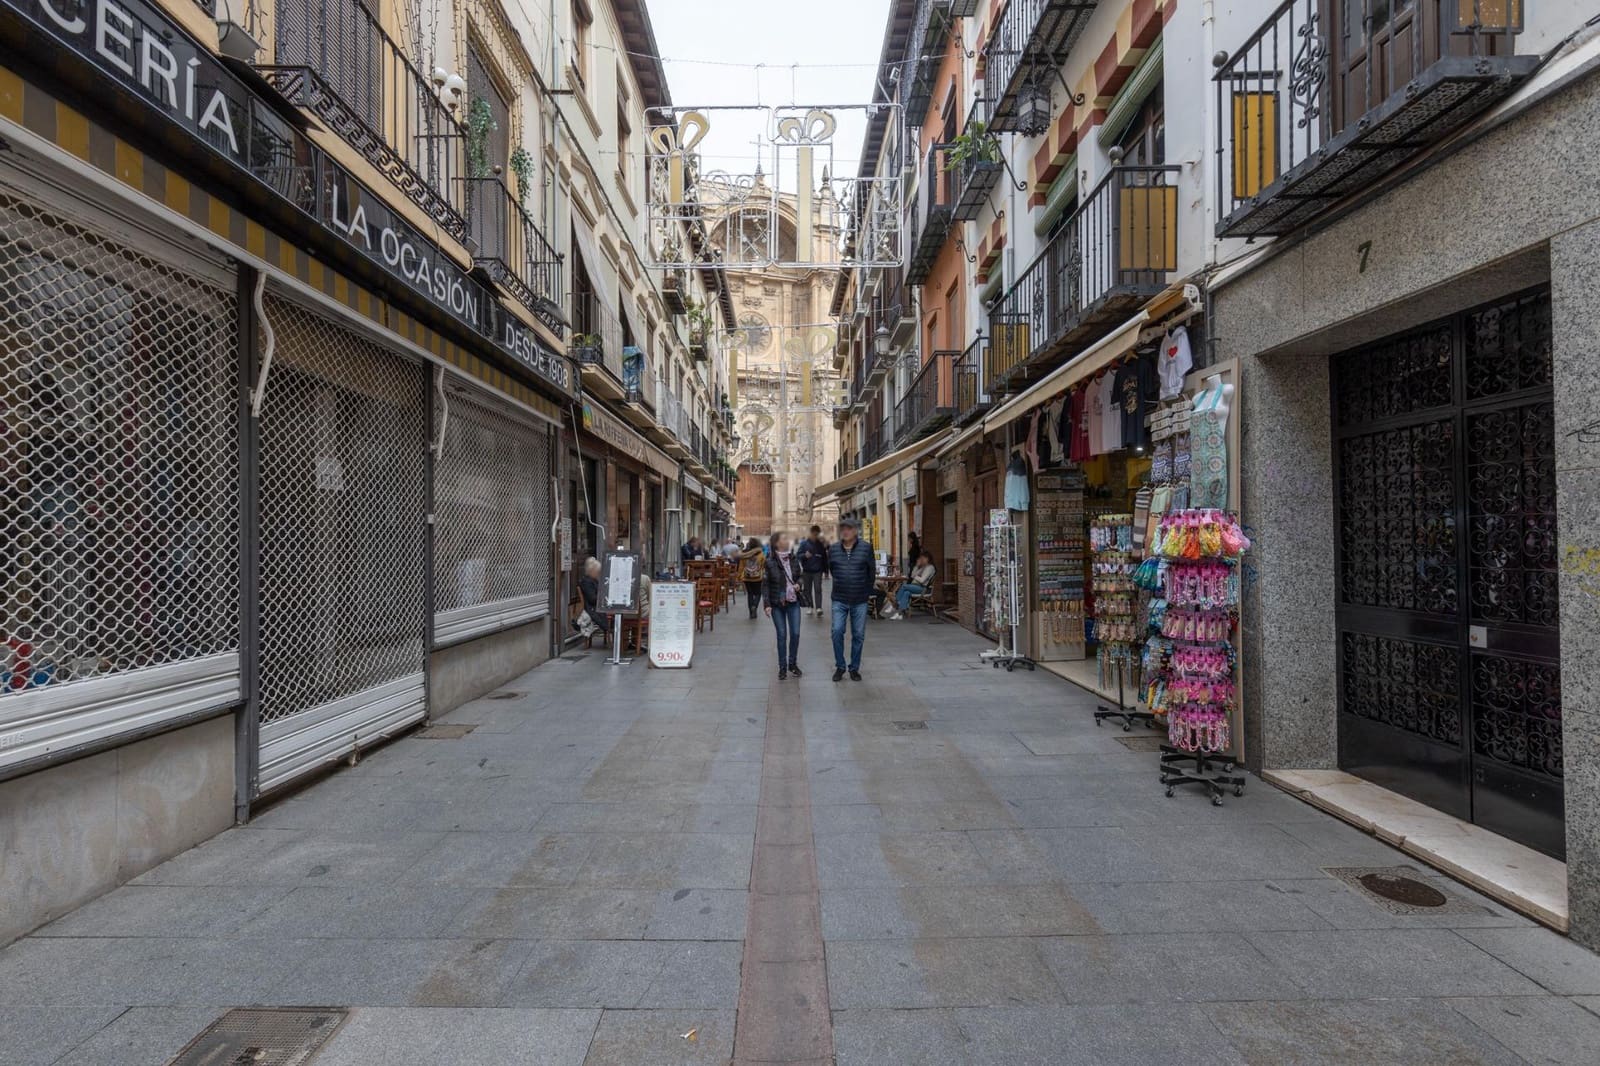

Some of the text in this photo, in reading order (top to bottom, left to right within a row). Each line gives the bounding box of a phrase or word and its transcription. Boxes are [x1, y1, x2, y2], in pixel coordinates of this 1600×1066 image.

[332, 183, 478, 325] LA OCASIÓN
[1358, 239, 1373, 274] 7
[505, 322, 569, 389] DESDE 1908
